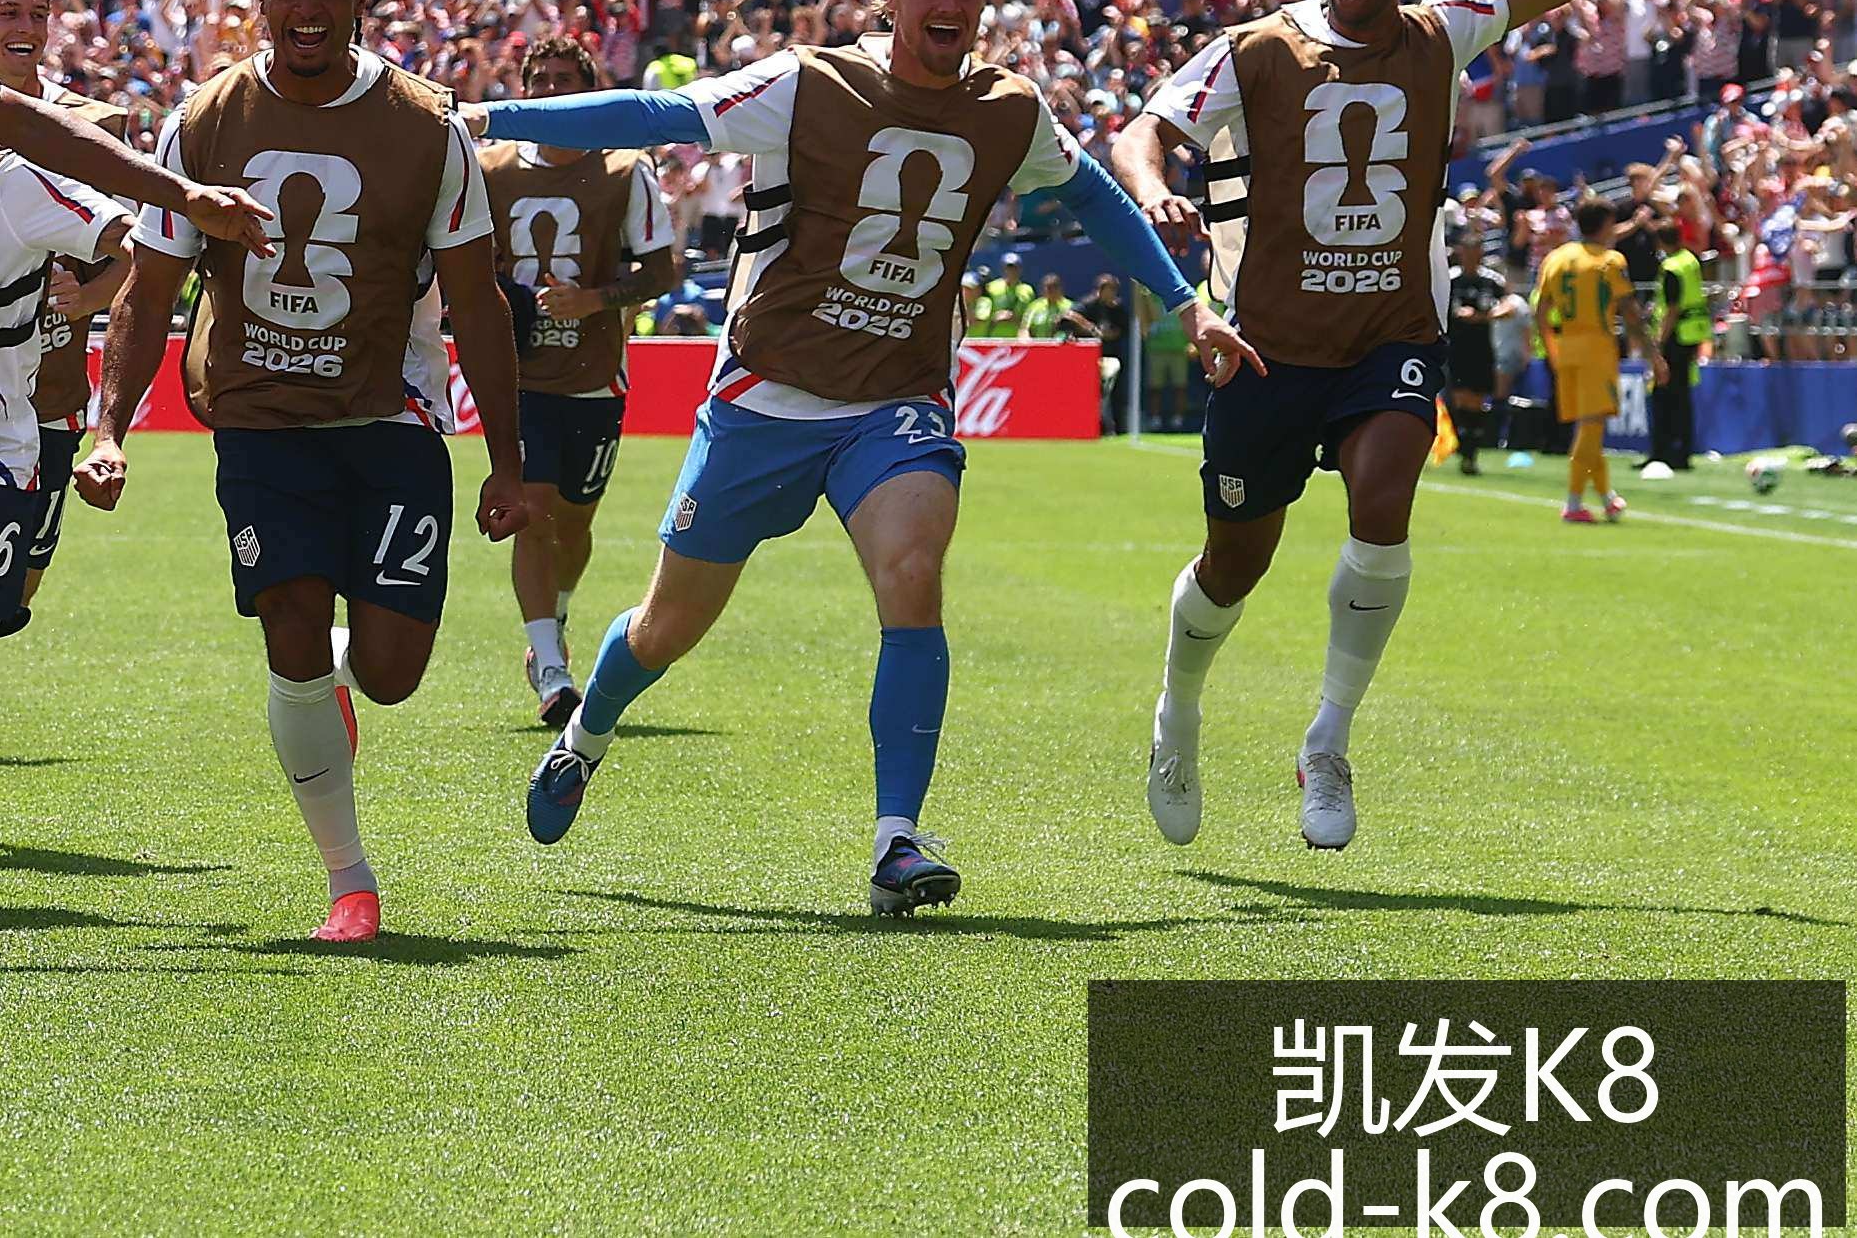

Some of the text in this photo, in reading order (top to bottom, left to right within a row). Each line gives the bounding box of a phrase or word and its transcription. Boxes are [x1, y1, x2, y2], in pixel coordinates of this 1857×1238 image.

[1335, 214, 1381, 232] FIFA
[869, 260, 915, 284] FIFA
[1302, 250, 1402, 267] WORLD CUP
[1301, 267, 1402, 294] 2026
[270, 291, 319, 314] FIFA
[825, 286, 891, 312] WORLD
[811, 302, 913, 339] 2026
[40, 325, 73, 354] 26
[243, 322, 347, 352] WORLD CUP
[530, 329, 580, 348] 026
[241, 341, 344, 378] 2026
[1400, 358, 1424, 387] 6
[893, 405, 947, 438] 23
[585, 439, 618, 483] 10
[1220, 476, 1242, 490] USA
[236, 528, 254, 549] USA
[373, 504, 439, 576] 12
